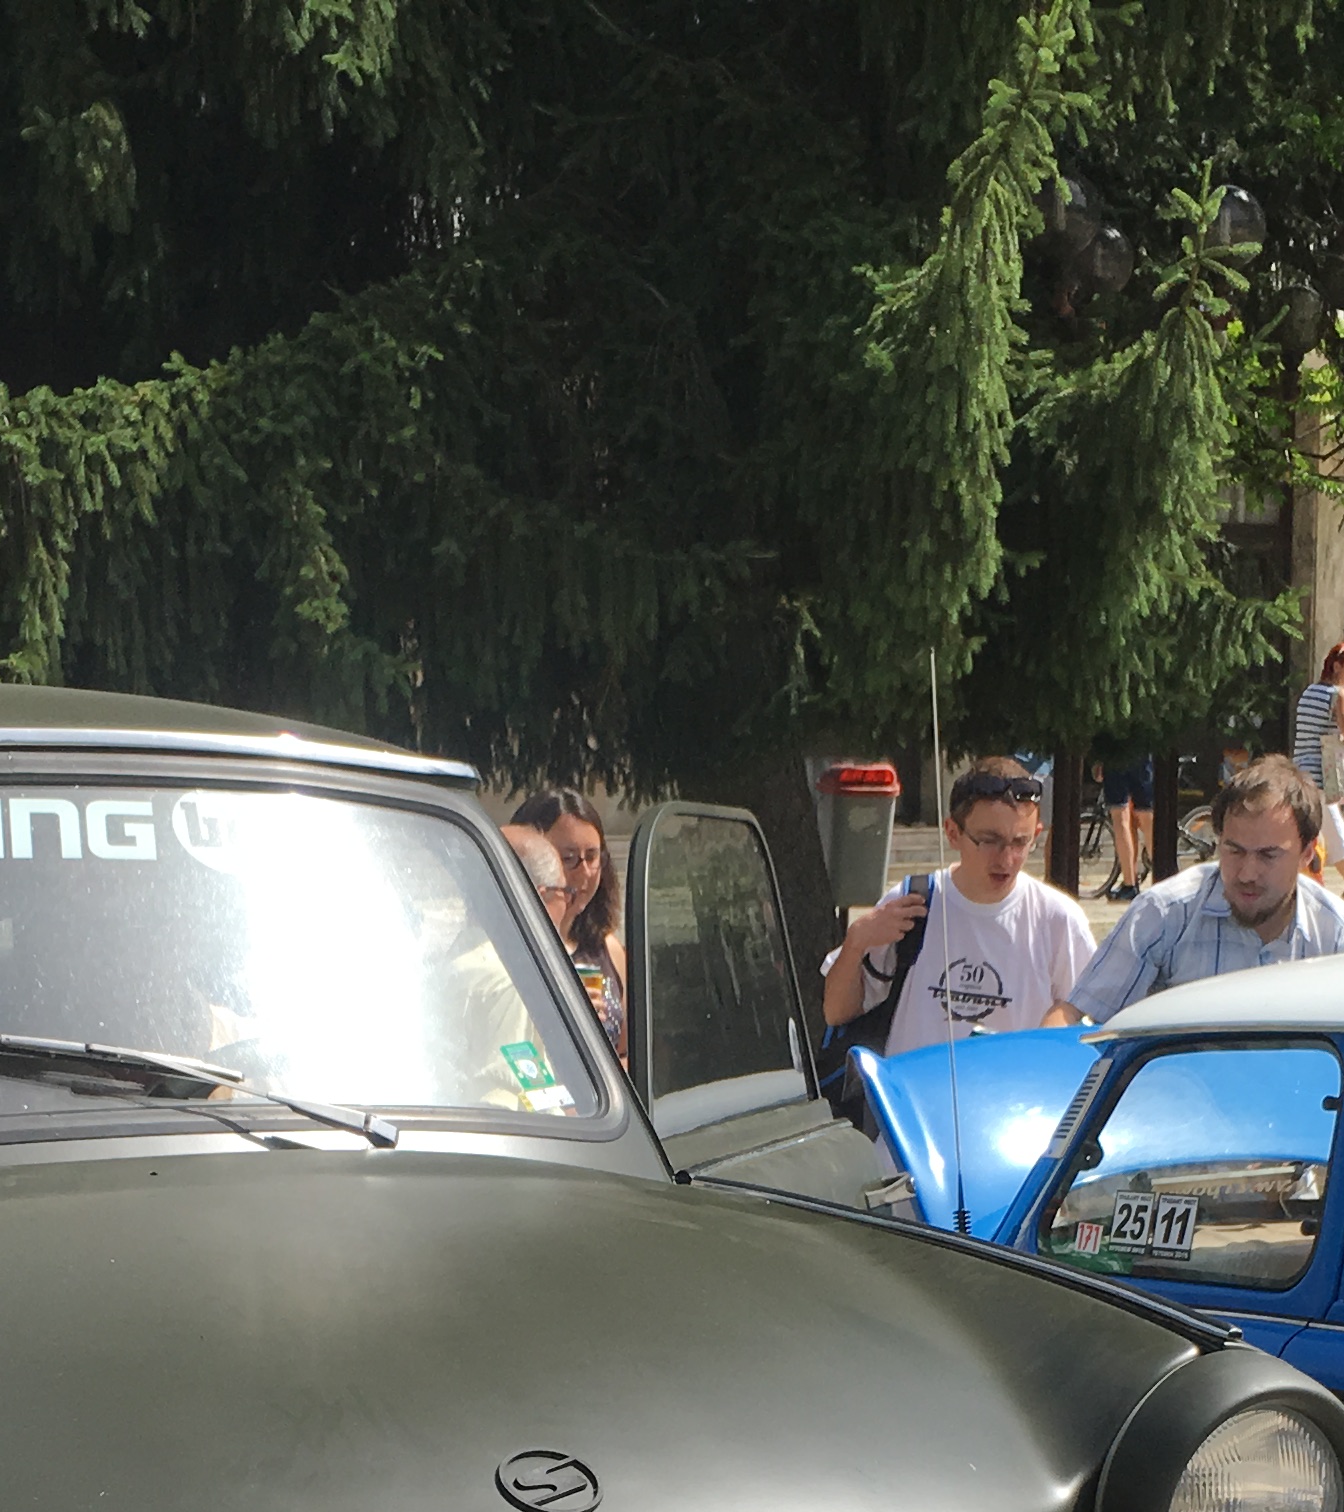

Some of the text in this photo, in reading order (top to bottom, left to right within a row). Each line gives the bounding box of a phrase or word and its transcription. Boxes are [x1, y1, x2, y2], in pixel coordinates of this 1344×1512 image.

[960, 964, 985, 984] 50
[1113, 1203, 1149, 1241] 25
[1160, 1206, 1192, 1246] 11
